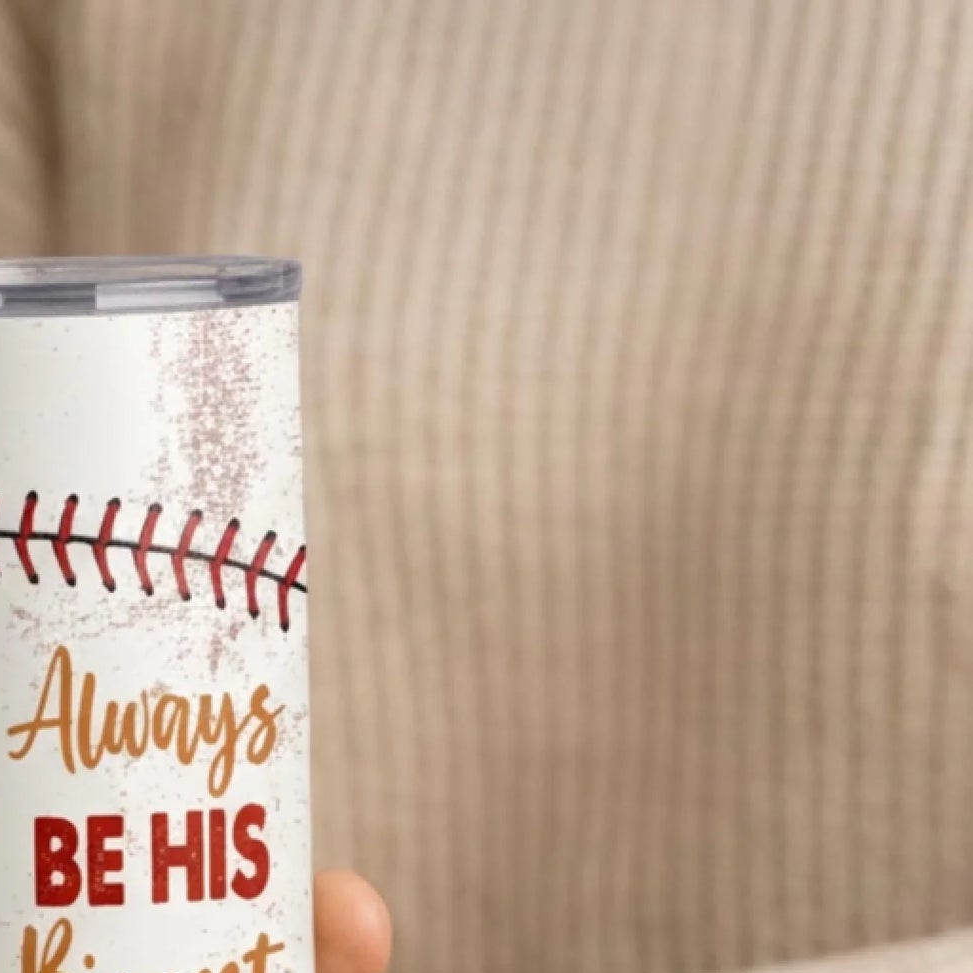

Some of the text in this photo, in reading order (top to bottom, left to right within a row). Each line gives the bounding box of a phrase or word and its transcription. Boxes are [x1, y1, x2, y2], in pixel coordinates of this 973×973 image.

[7, 645, 285, 797] Always
[33, 803, 270, 907] BE HIS
